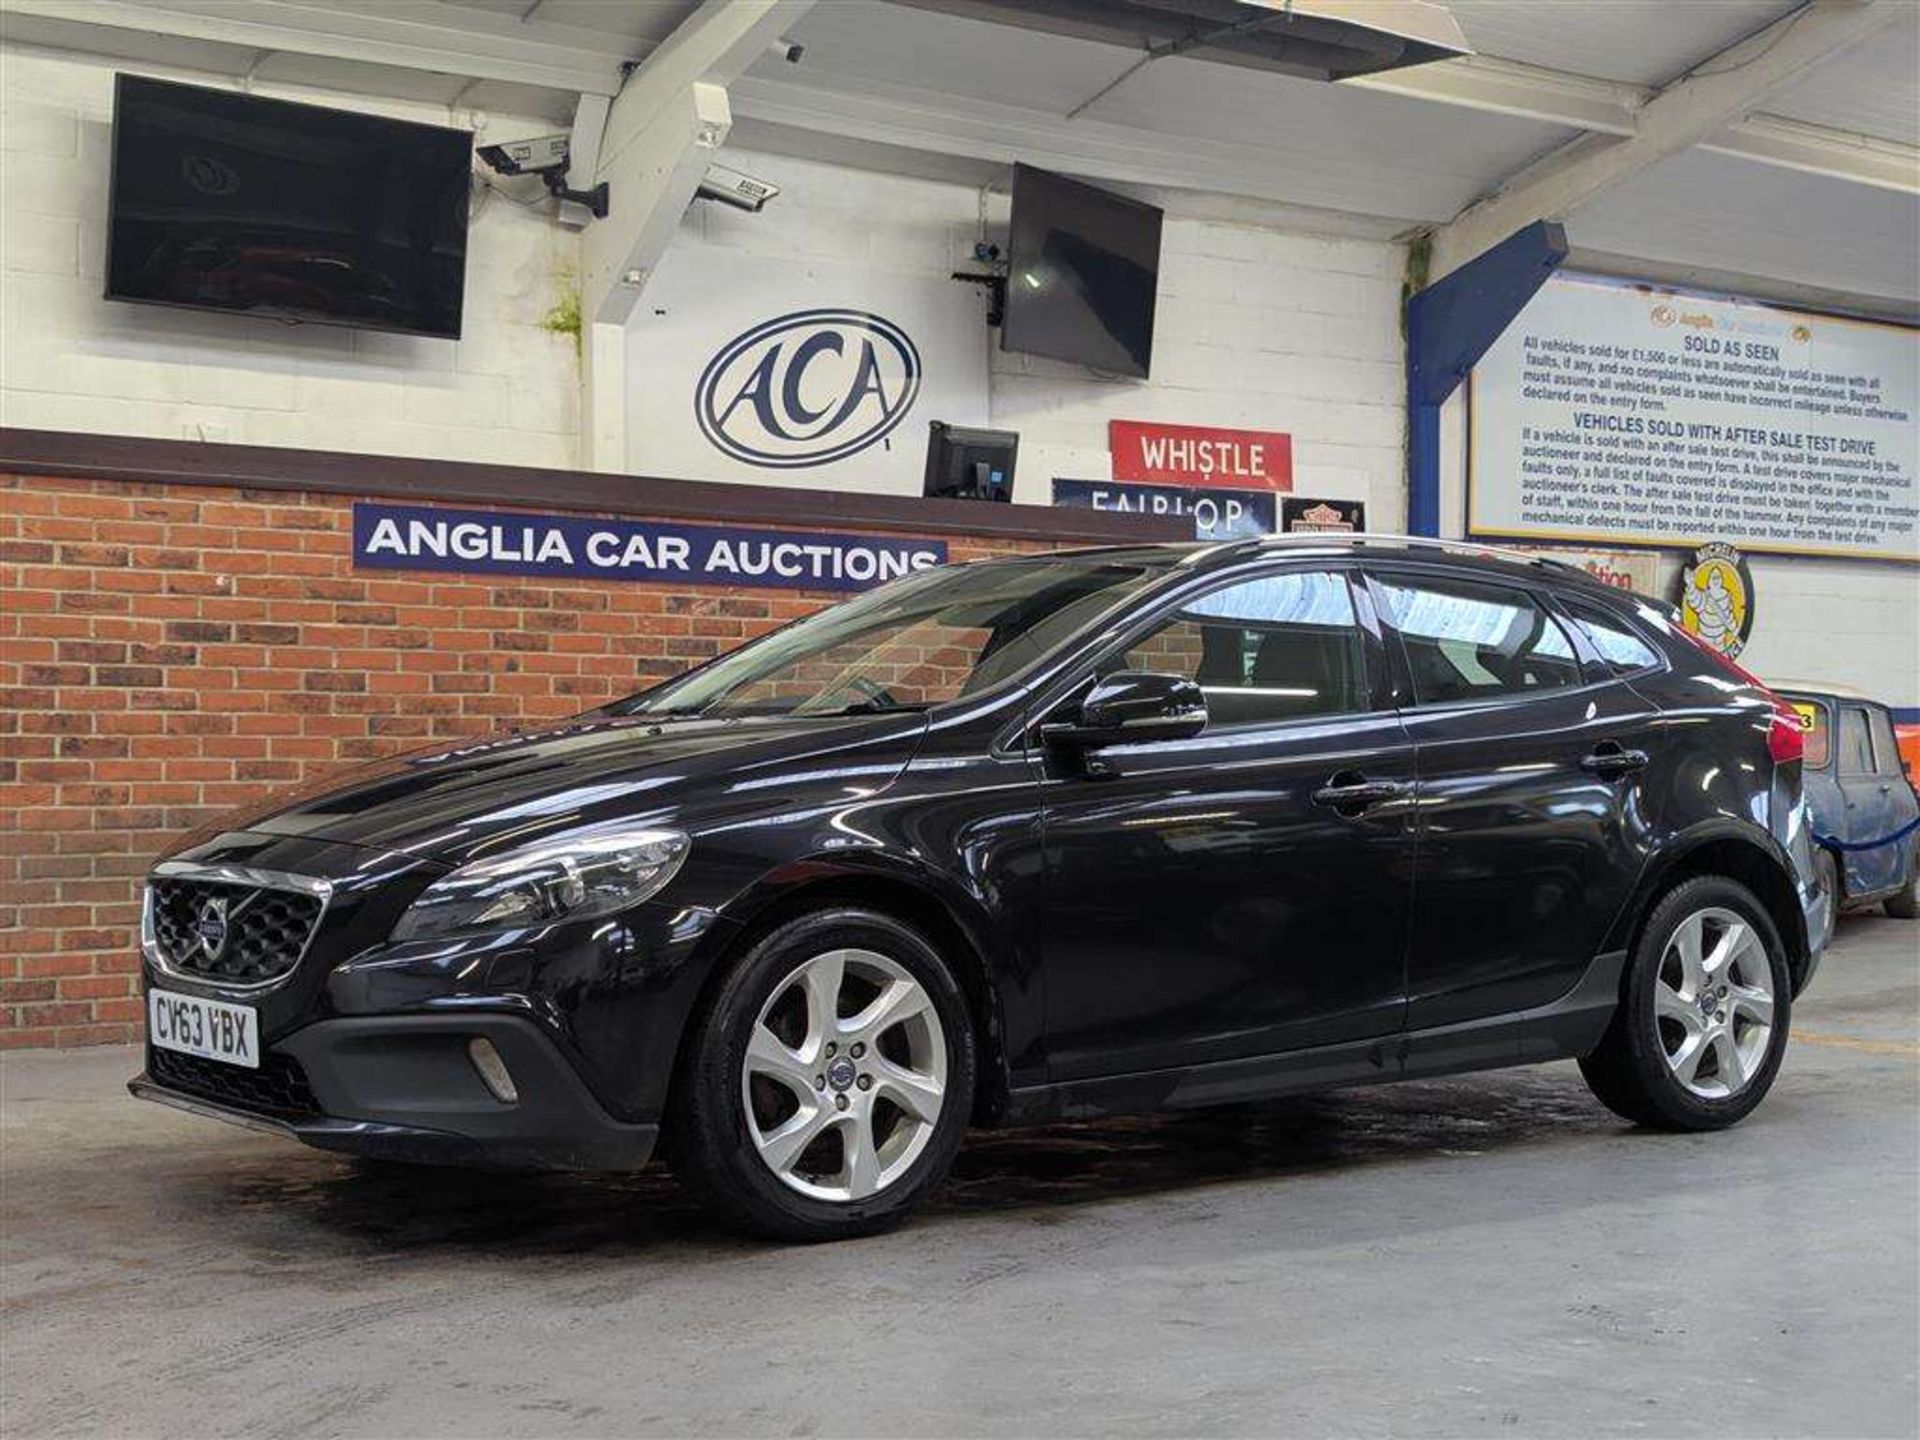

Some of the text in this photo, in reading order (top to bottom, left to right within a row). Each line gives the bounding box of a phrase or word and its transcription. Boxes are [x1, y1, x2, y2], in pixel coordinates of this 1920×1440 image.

[1523, 336, 1538, 348] All
[1541, 339, 1585, 354] vehicles
[1588, 344, 1611, 357] sold
[1614, 347, 1628, 359] for
[1668, 355, 1678, 364] or
[1681, 357, 1701, 367] less
[1704, 360, 1719, 370] are
[1722, 361, 1785, 378] automatically
[1788, 368, 1808, 380] sold
[1810, 372, 1821, 382] as
[1824, 374, 1845, 384] seen
[1848, 376, 1866, 386] with
[1869, 377, 1879, 388] all
[1684, 335, 1778, 361] SOLD AS SEEN
[714, 330, 888, 441] ACA
[1523, 371, 1550, 382] must
[1554, 375, 1595, 387] assume
[1598, 377, 1610, 389] all
[1614, 379, 1656, 393] vehicles
[1660, 384, 1680, 396] sold
[1683, 388, 1695, 398] as
[1698, 390, 1721, 400] seen
[1724, 392, 1746, 403] have
[1749, 395, 1791, 407] incorrect
[1794, 401, 1830, 414] mileage
[1833, 405, 1862, 416] unless
[1523, 386, 1570, 400] declared
[1573, 393, 1586, 403] on
[1590, 393, 1606, 404] the
[1610, 396, 1636, 410] entry
[1563, 356, 1570, 368] if
[1598, 361, 1618, 373] and
[1620, 366, 1633, 375] no
[1636, 367, 1691, 381] complaints
[1694, 374, 1749, 388] whatsoever
[1753, 379, 1775, 391] shall
[1778, 382, 1789, 393] be
[1849, 390, 1880, 403] Buyers
[1522, 427, 1530, 438] If
[1533, 430, 1539, 440] a
[1543, 429, 1580, 443] vehicle
[1584, 433, 1593, 445] is
[1596, 435, 1619, 447] sold
[1622, 437, 1644, 449] with
[1647, 441, 1659, 450] an
[1662, 441, 1684, 452] after
[1688, 443, 1707, 455] sale
[1710, 445, 1729, 457] test
[1761, 450, 1778, 461] this
[1782, 451, 1804, 463] shall
[1806, 453, 1818, 464] be
[1821, 457, 1870, 468] announced
[1872, 460, 1882, 472] by
[1886, 461, 1899, 471] the
[1573, 413, 1875, 454] VEHICLES SOLD WITH AFTER SALE TEST DRIVE
[1141, 436, 1265, 476] WHISTLE
[1522, 447, 1579, 459] auctioneer
[1582, 450, 1602, 461] and
[1605, 452, 1651, 465] declared
[1654, 457, 1666, 467] on
[1668, 457, 1684, 468] the
[1687, 460, 1712, 472] entry
[1743, 463, 1750, 473] A
[1752, 465, 1770, 476] test
[1773, 466, 1797, 478] drive
[1800, 470, 1830, 480] covers
[1834, 473, 1858, 483] major
[1861, 476, 1911, 487] mechanical
[1522, 461, 1552, 473] faults
[1584, 468, 1590, 477] a
[1593, 466, 1610, 478] full
[1612, 467, 1629, 479] list
[1632, 469, 1642, 481] of
[1645, 471, 1673, 483] faults
[1676, 475, 1716, 486] covered
[1718, 477, 1726, 487] is
[1729, 478, 1776, 492] displayed
[1778, 481, 1786, 492] in
[1790, 483, 1804, 493] the
[1807, 483, 1832, 495] office
[1836, 487, 1852, 497] and
[1854, 488, 1872, 498] with
[1875, 490, 1889, 500] the
[1623, 484, 1642, 496] The
[1645, 487, 1668, 498] after
[1671, 490, 1691, 500] sale
[1694, 490, 1713, 502] test
[1715, 491, 1739, 504] drive
[1742, 495, 1766, 505] must
[1768, 496, 1780, 507] be
[1814, 500, 1852, 512] together
[1856, 503, 1873, 513] with
[1876, 506, 1881, 514] a
[1884, 507, 1918, 517] member
[1522, 493, 1533, 505] of
[1566, 497, 1598, 508] within
[1601, 501, 1620, 511] one
[1623, 501, 1647, 512] hour
[1650, 502, 1674, 514] from
[1676, 504, 1692, 516] the
[1694, 505, 1710, 517] fall
[1713, 507, 1722, 518] of
[1725, 508, 1739, 519] the
[1786, 512, 1804, 524] Any
[1806, 515, 1856, 528] complaints
[1859, 517, 1867, 528] of
[1870, 520, 1885, 532] any
[1888, 521, 1912, 532] major
[1522, 511, 1584, 524] mechanical
[1586, 515, 1625, 527] defects
[1628, 518, 1654, 529] must
[1656, 519, 1669, 530] be
[1672, 521, 1714, 534] reported
[1718, 523, 1746, 534] within
[1749, 526, 1766, 536] one
[1769, 527, 1790, 537] hour
[1793, 527, 1814, 538] from
[1818, 529, 1832, 539] the
[1834, 531, 1851, 541] test
[366, 518, 938, 580] ANGLIA CAR AUCTIONS
[157, 997, 248, 1057] CV63 VBX
